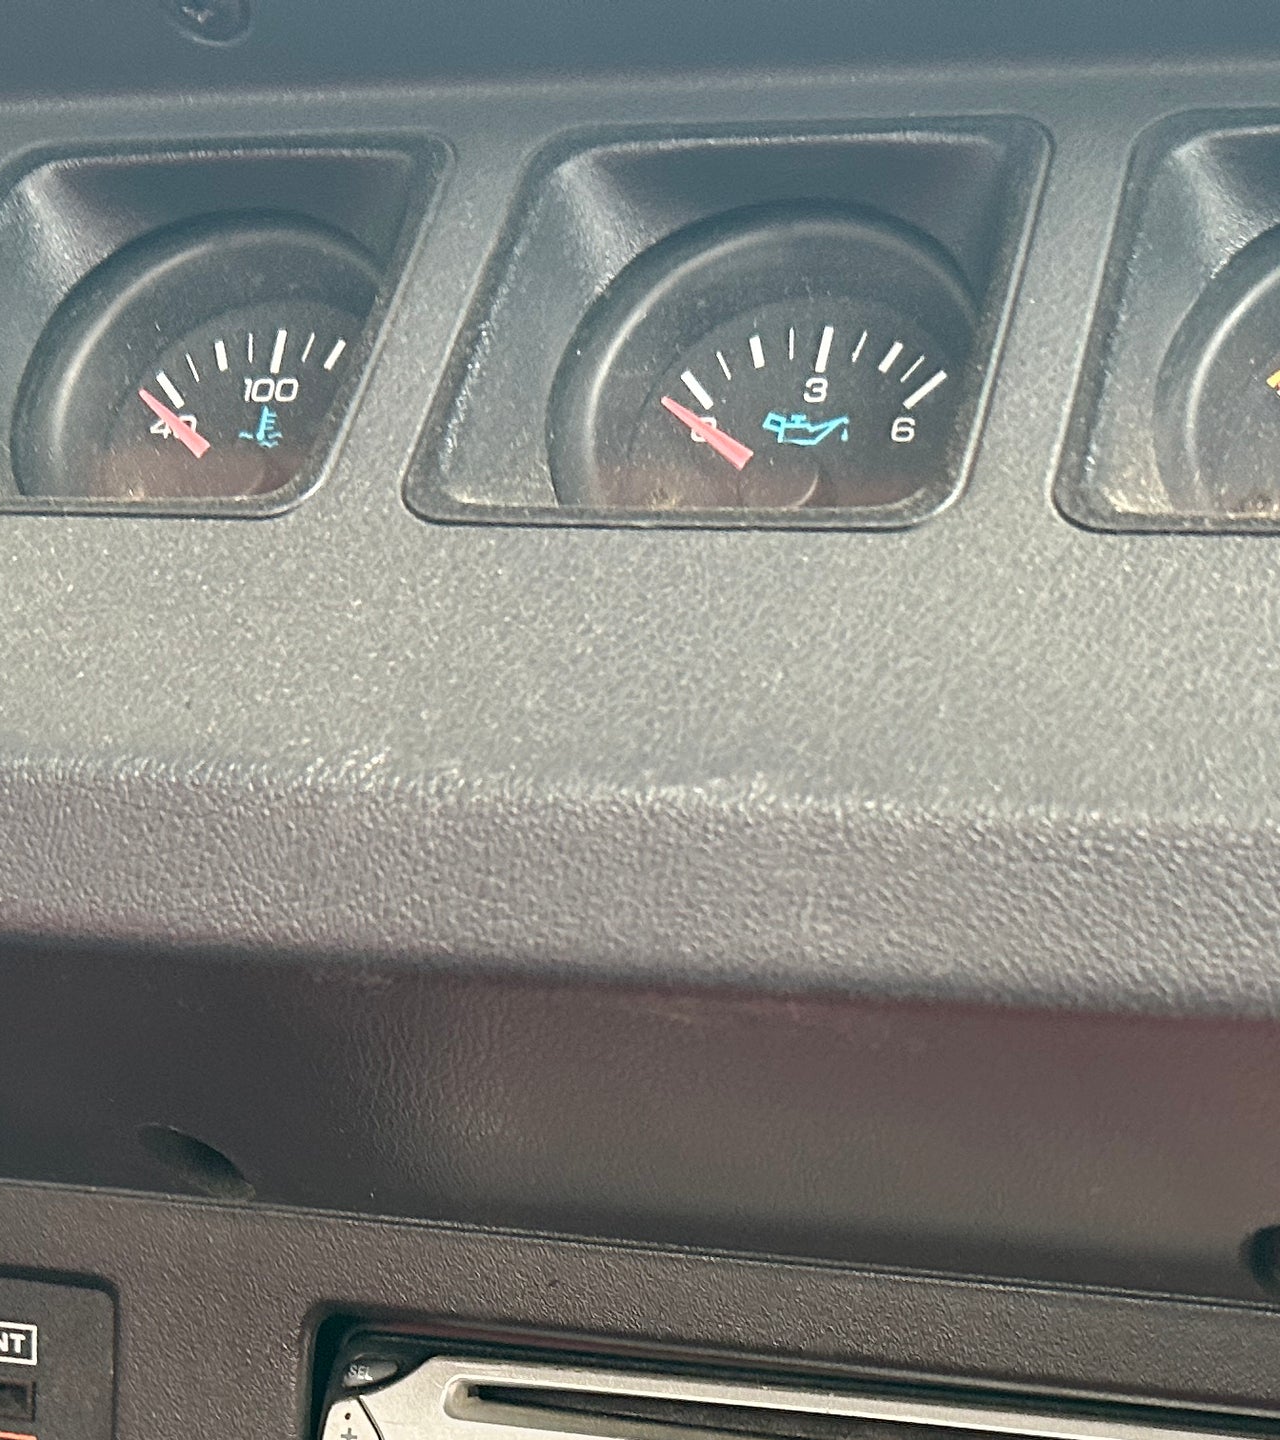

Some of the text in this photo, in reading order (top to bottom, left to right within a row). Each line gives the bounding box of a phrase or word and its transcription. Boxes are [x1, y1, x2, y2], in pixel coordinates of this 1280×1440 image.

[244, 378, 299, 402] 100
[803, 377, 828, 403] 3
[891, 416, 916, 442] 6
[348, 1364, 373, 1381] SEL
